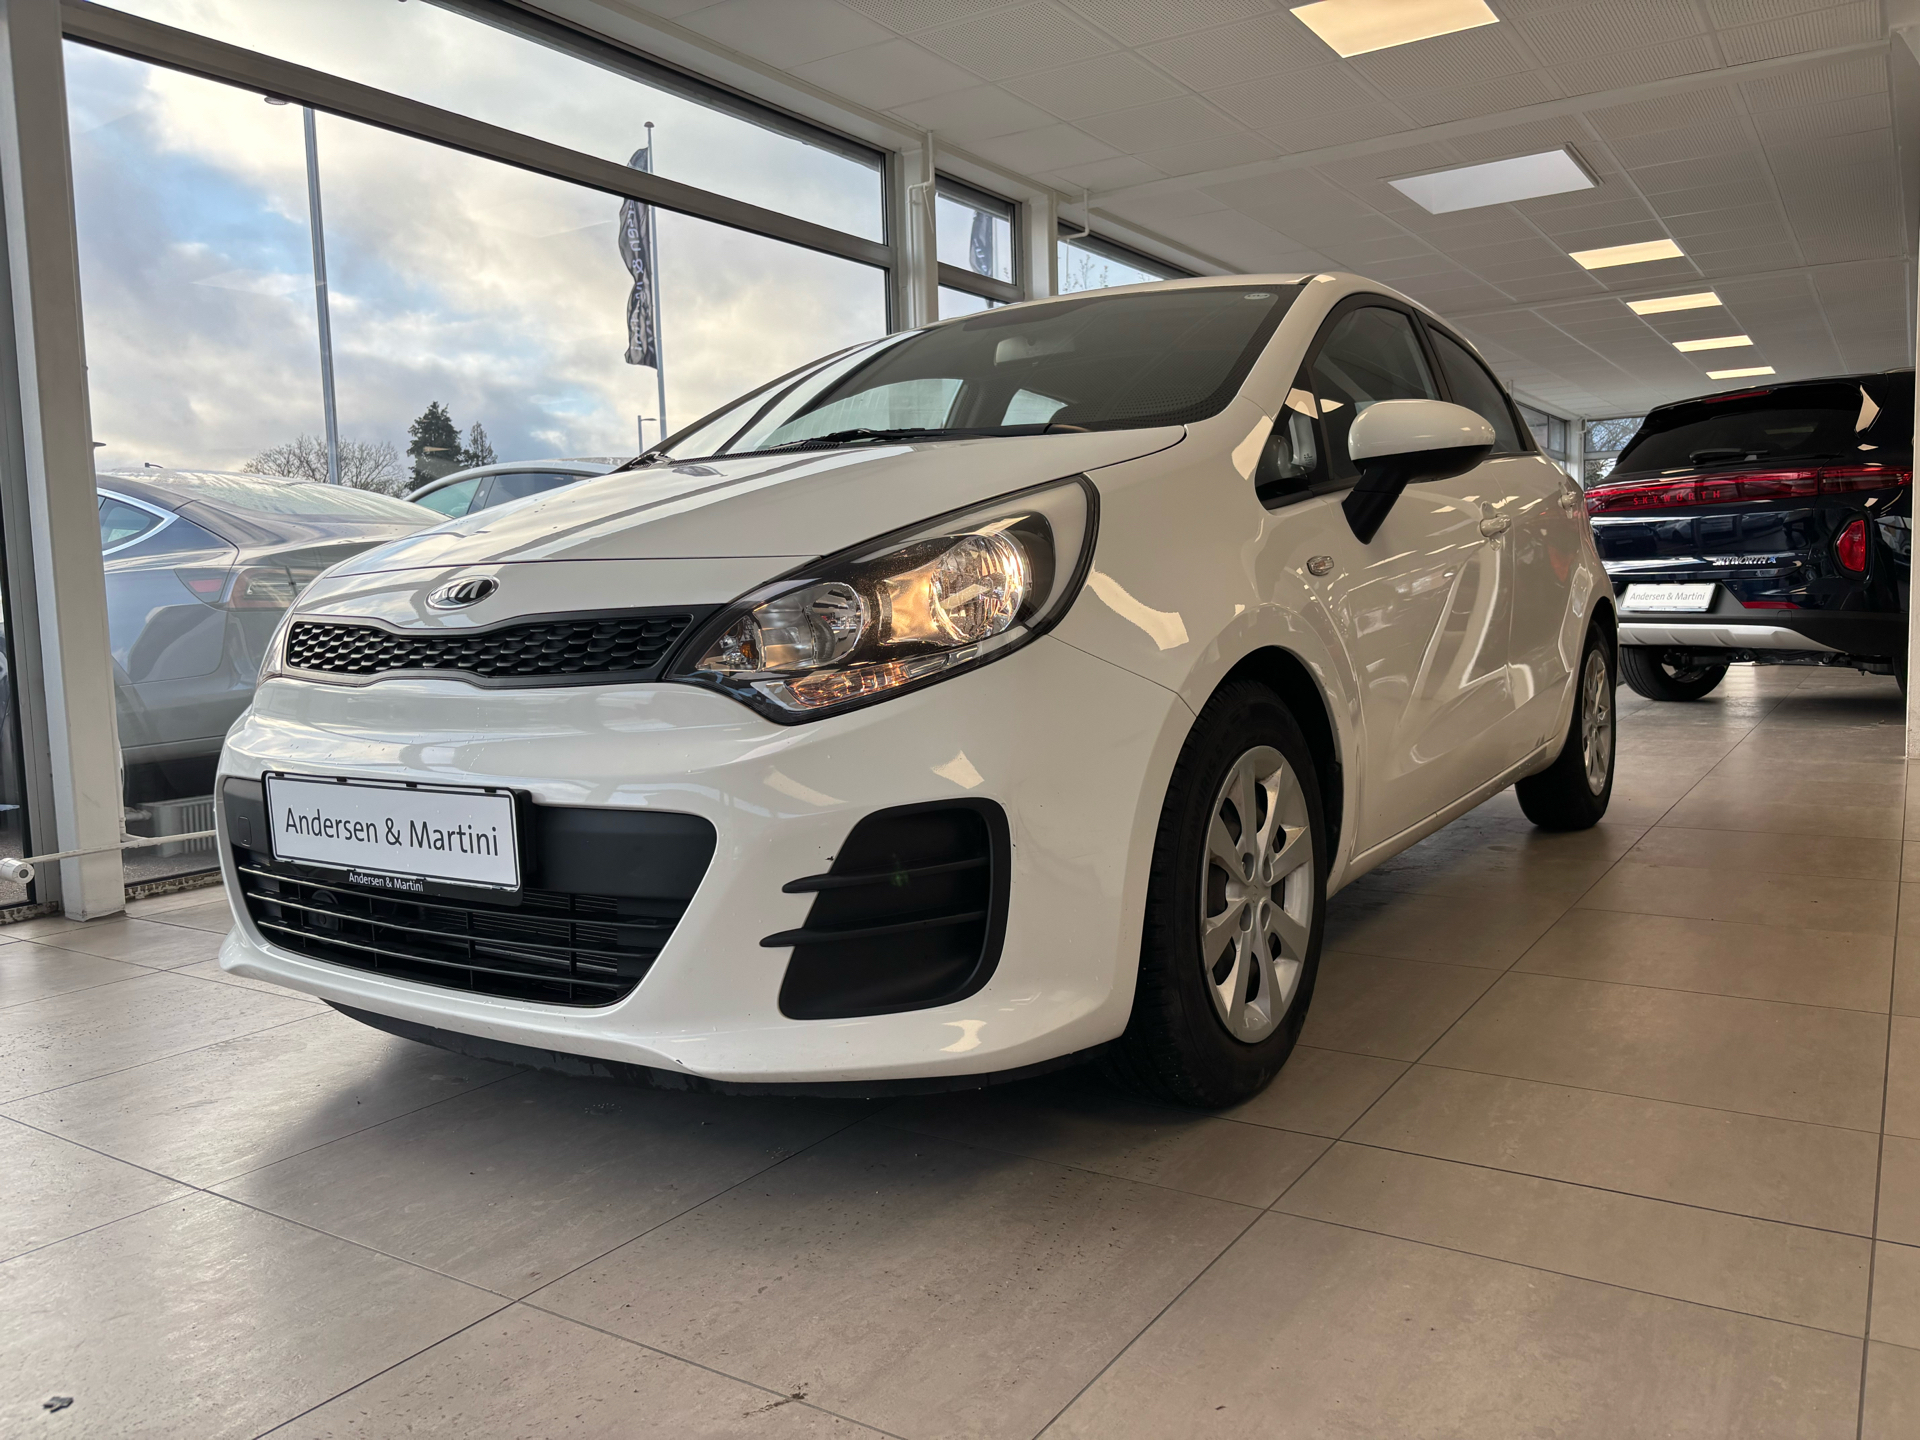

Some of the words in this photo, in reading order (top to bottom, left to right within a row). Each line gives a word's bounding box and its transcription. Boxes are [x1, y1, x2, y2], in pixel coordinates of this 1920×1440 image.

[1633, 490, 1721, 506] SKYWORTH
[1630, 592, 1665, 601] Andersen
[1674, 592, 1706, 601] Martini
[285, 807, 379, 844] Andersen
[385, 817, 402, 846] &
[410, 819, 499, 857] Martini
[349, 872, 384, 887] Andersen
[385, 877, 393, 888] &
[394, 878, 424, 892] Martini
